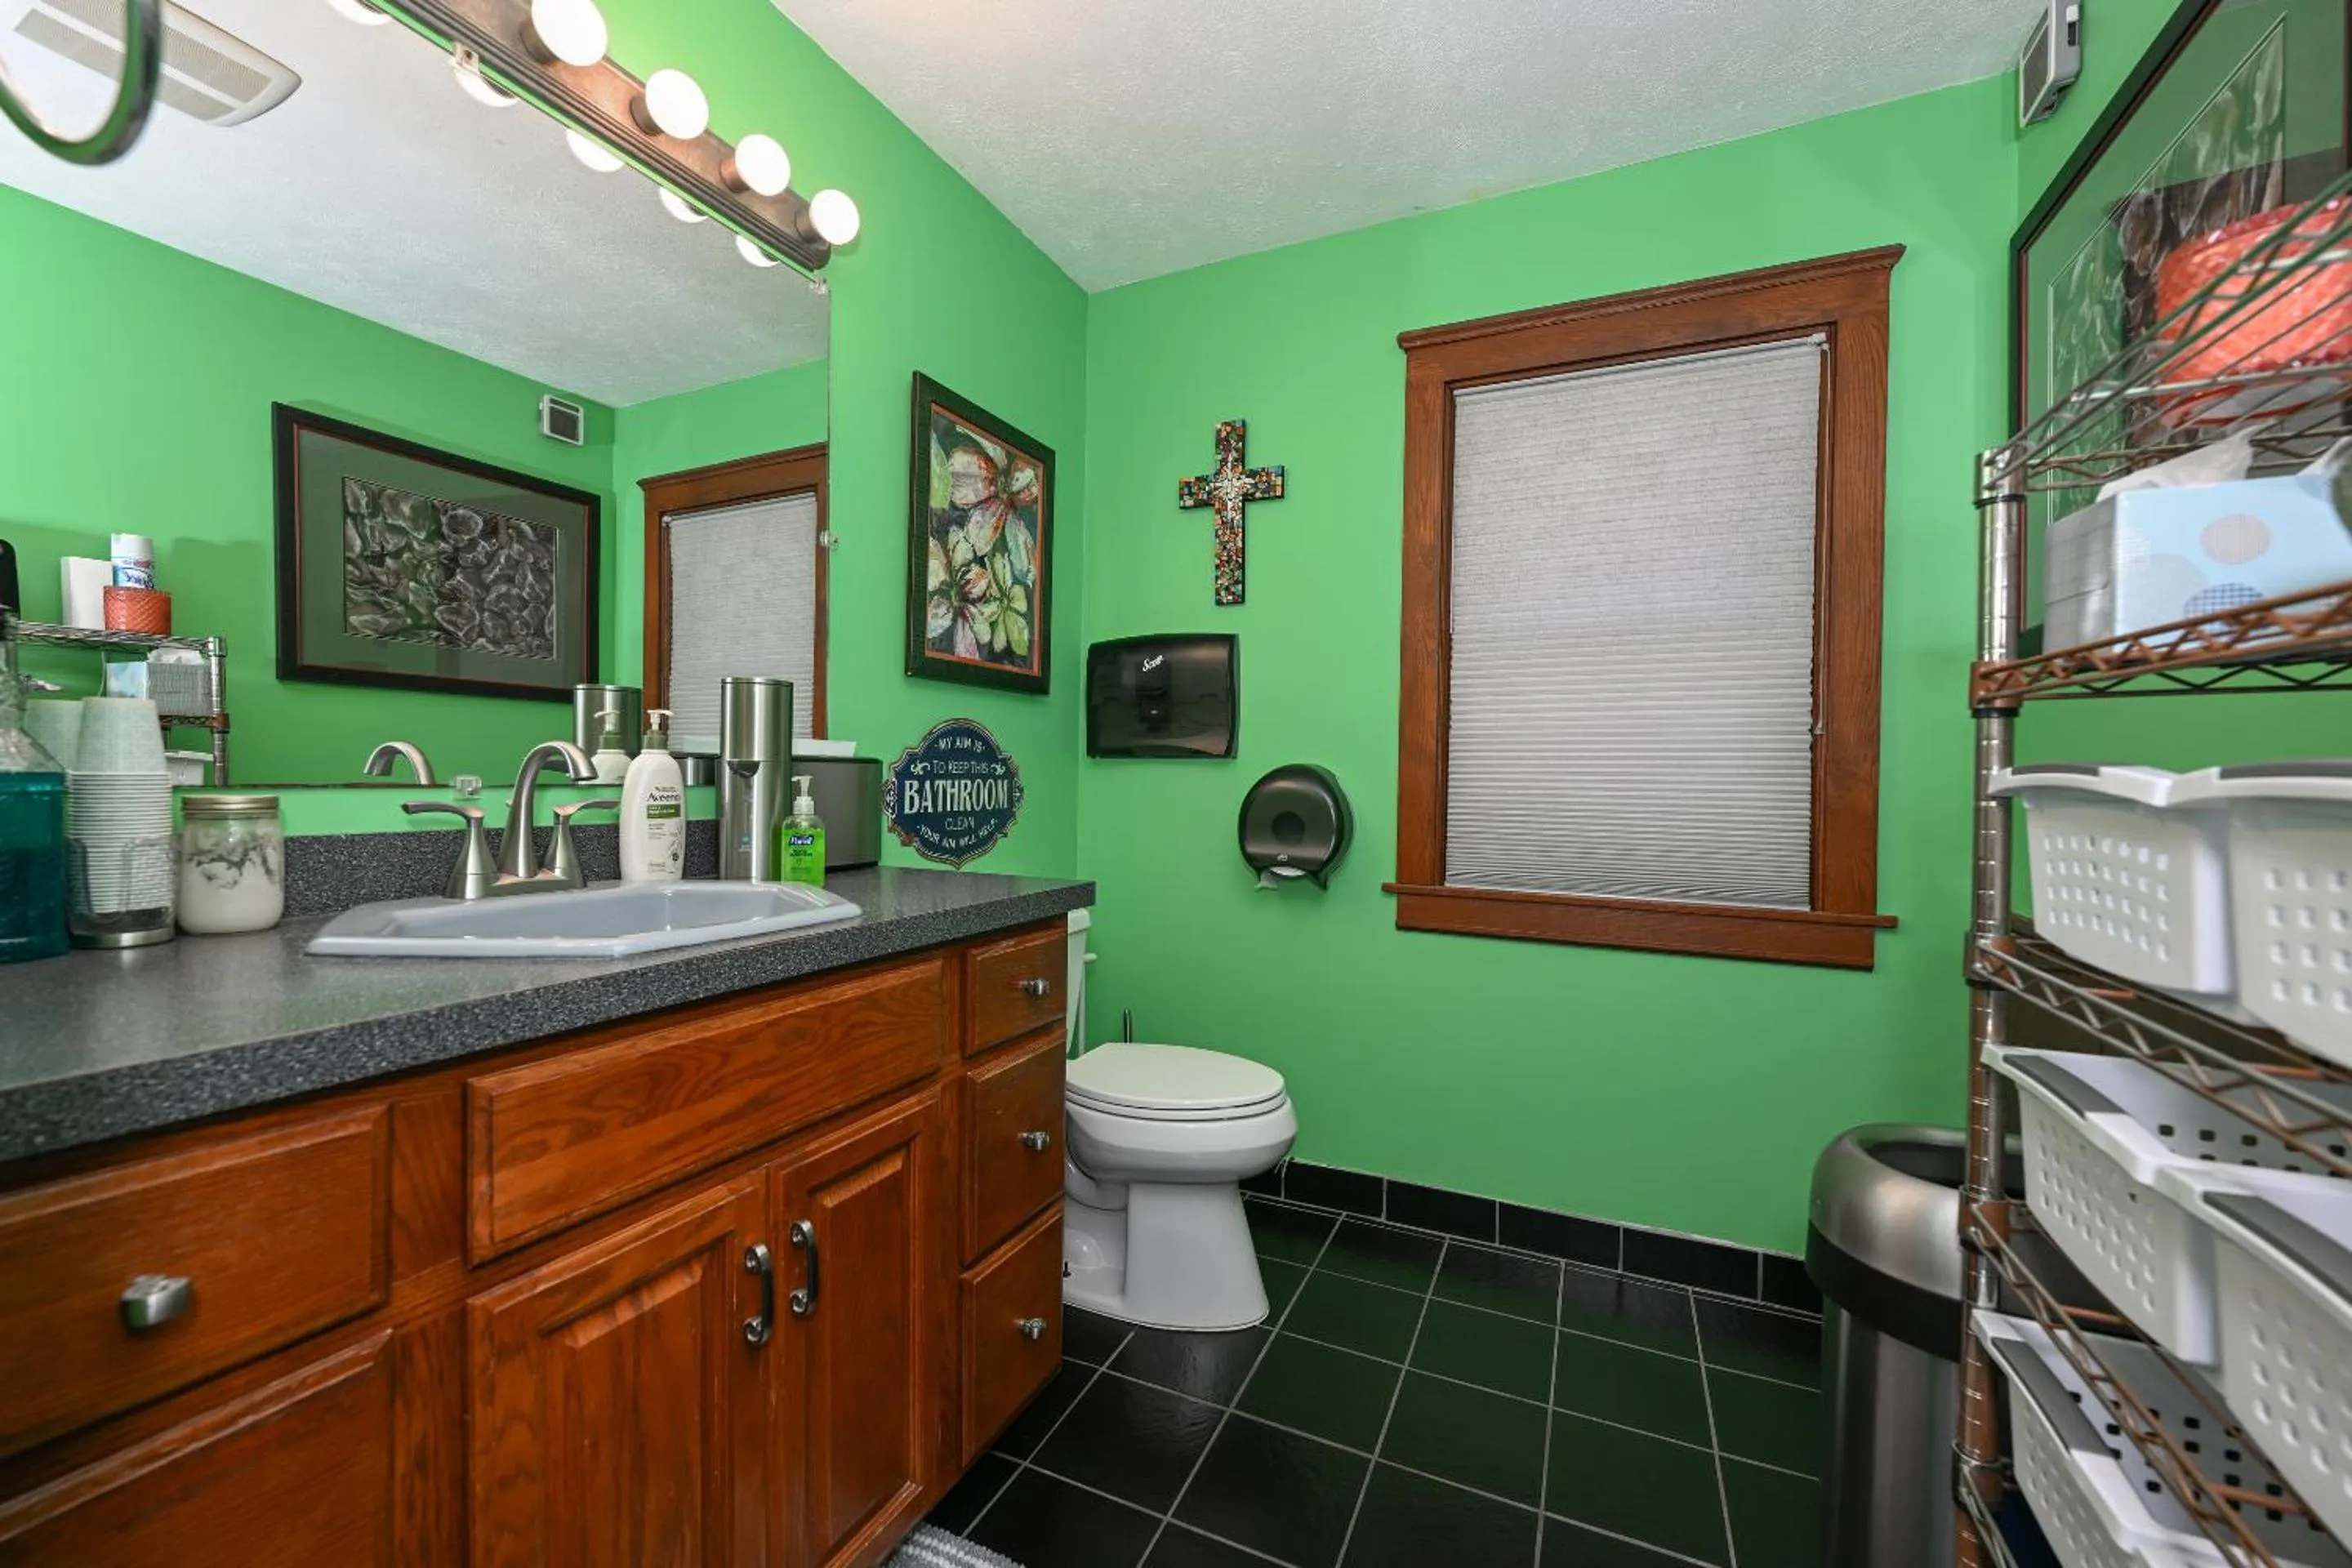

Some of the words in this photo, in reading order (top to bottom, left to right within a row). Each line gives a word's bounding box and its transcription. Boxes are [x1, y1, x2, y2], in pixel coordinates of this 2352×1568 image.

[939, 737, 952, 750] MY
[955, 737, 971, 749] AIM
[973, 740, 982, 752] IS
[933, 760, 946, 773] TO
[948, 760, 969, 773] KEEP
[971, 760, 989, 773] THIS
[904, 778, 1008, 814] BATHROOM
[945, 817, 974, 830] CLEAN
